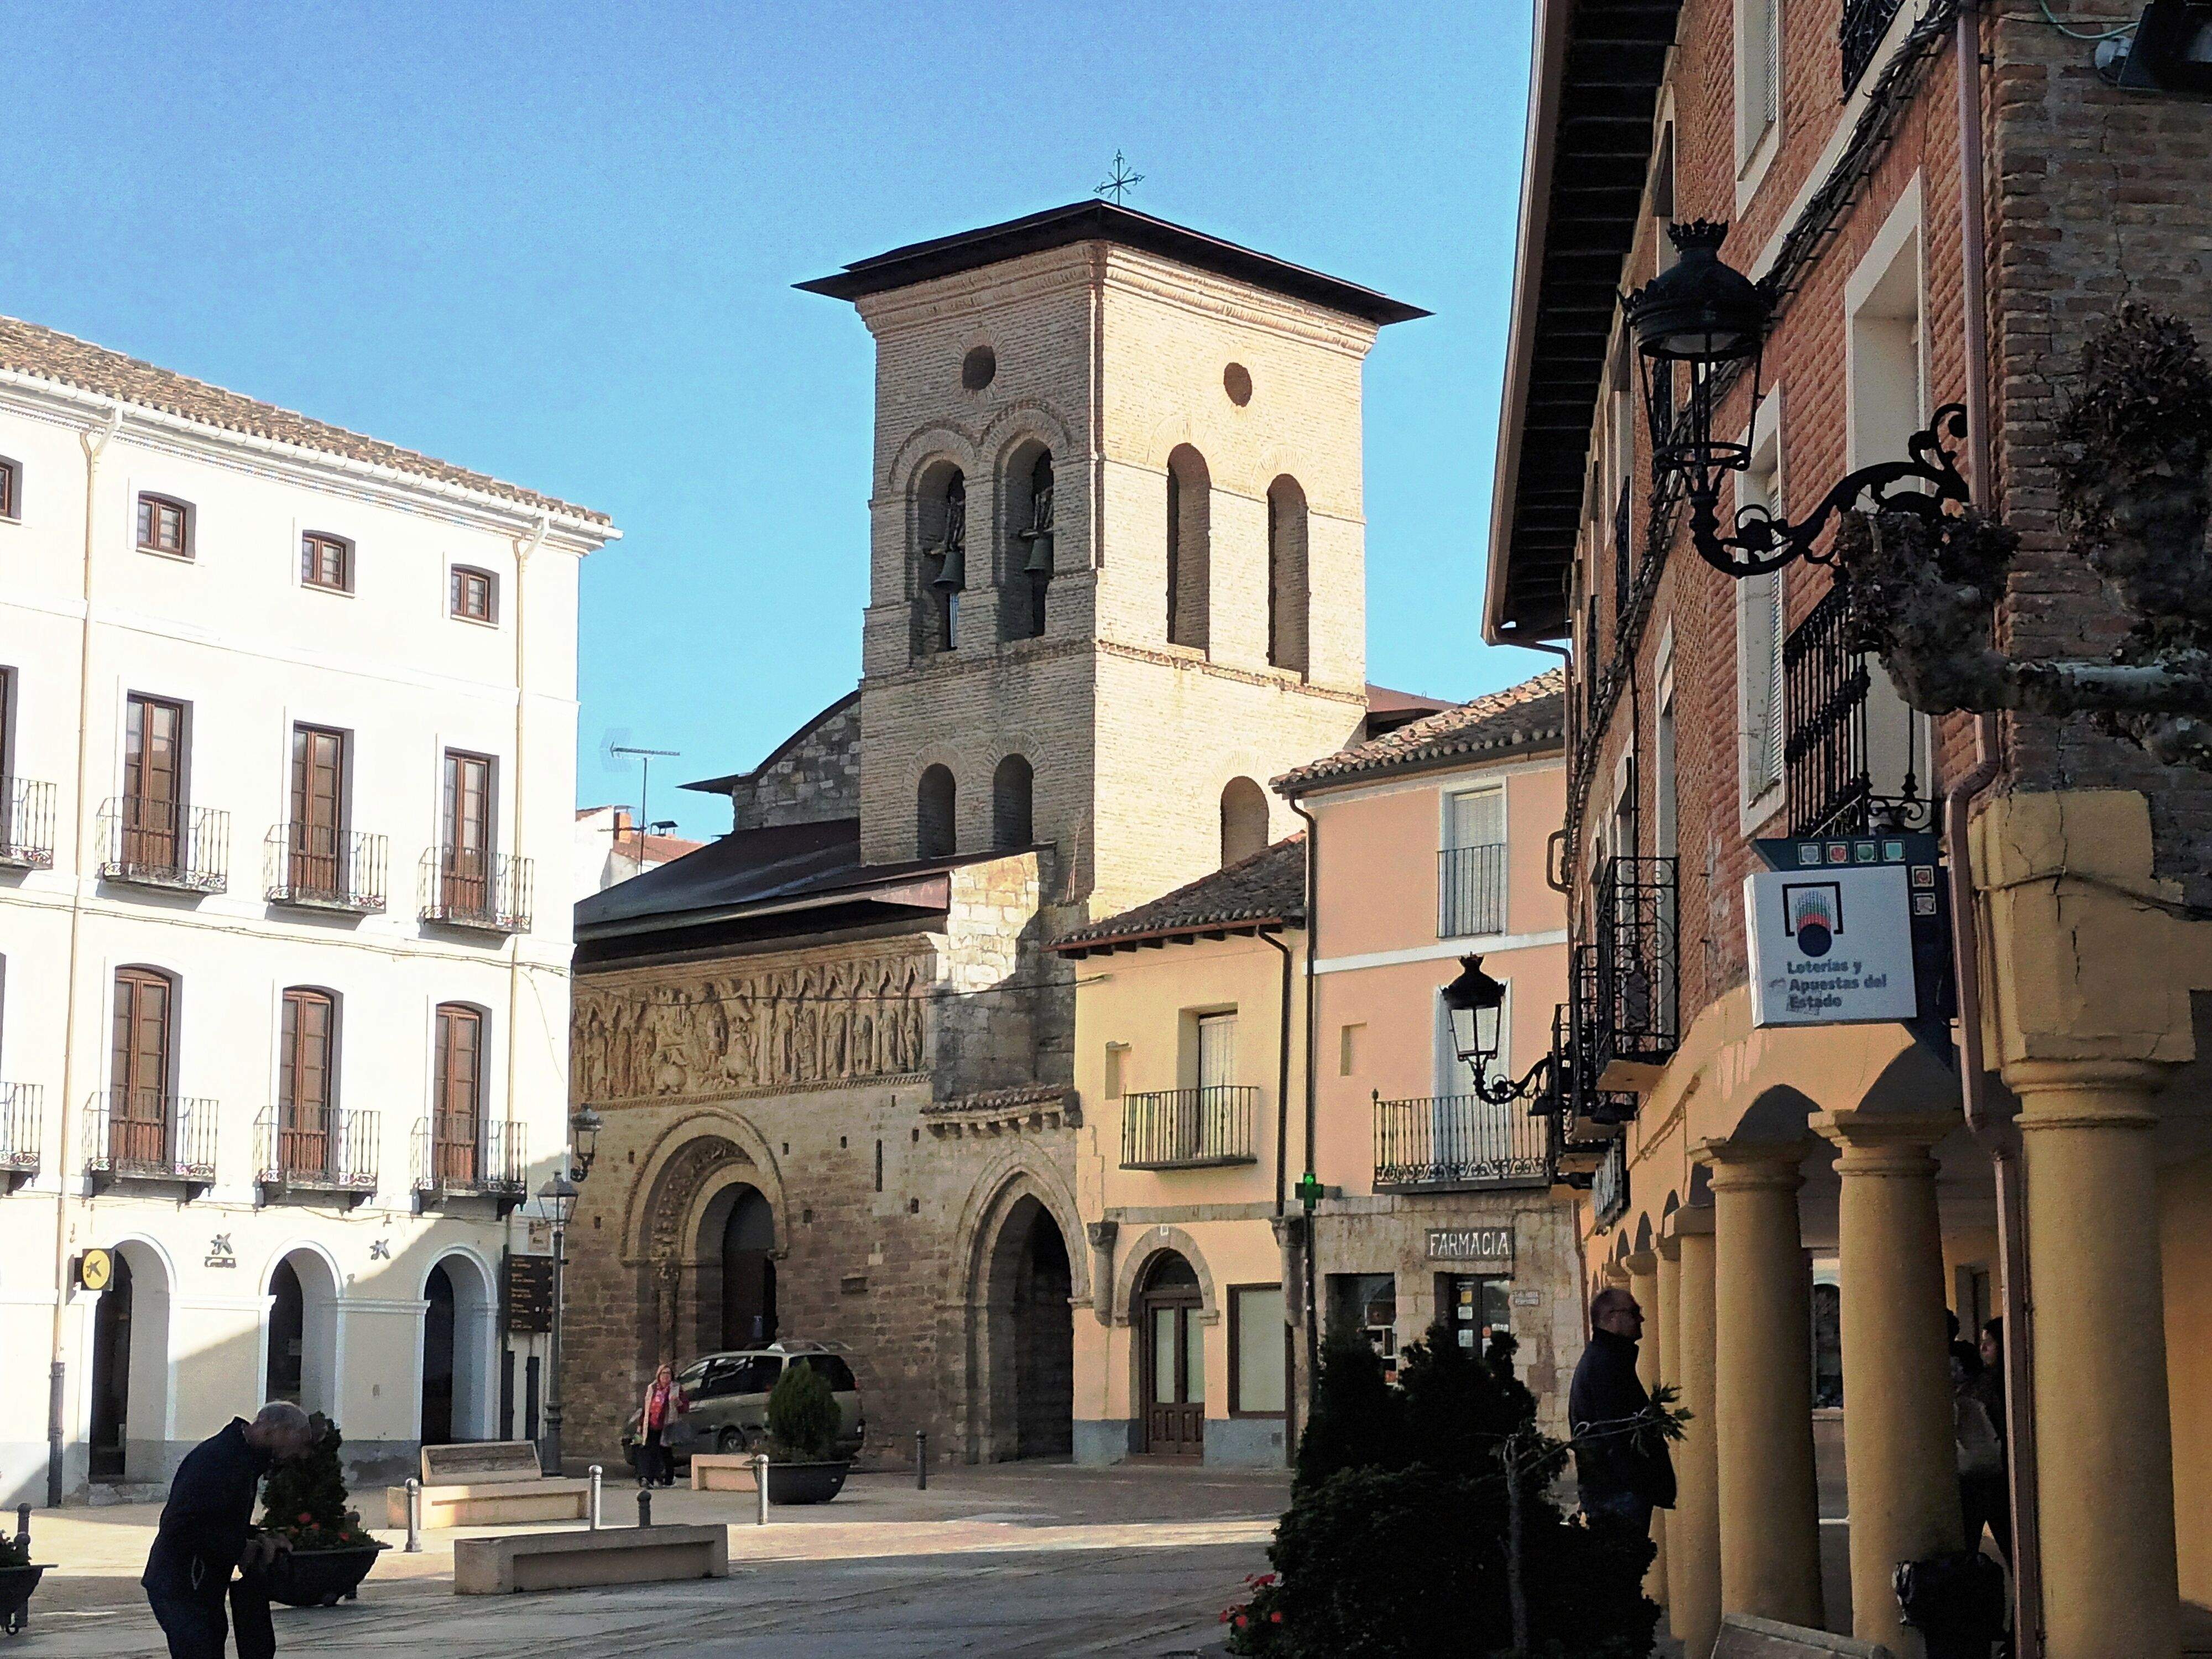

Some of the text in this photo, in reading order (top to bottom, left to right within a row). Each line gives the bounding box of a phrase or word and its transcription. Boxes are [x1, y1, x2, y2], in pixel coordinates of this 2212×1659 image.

[1787, 958, 1861, 975] Loterías y
[1789, 973, 1887, 995] Apuestas del
[1789, 994, 1842, 1009] Estado
[1430, 1232, 1511, 1255] FARMACIA
